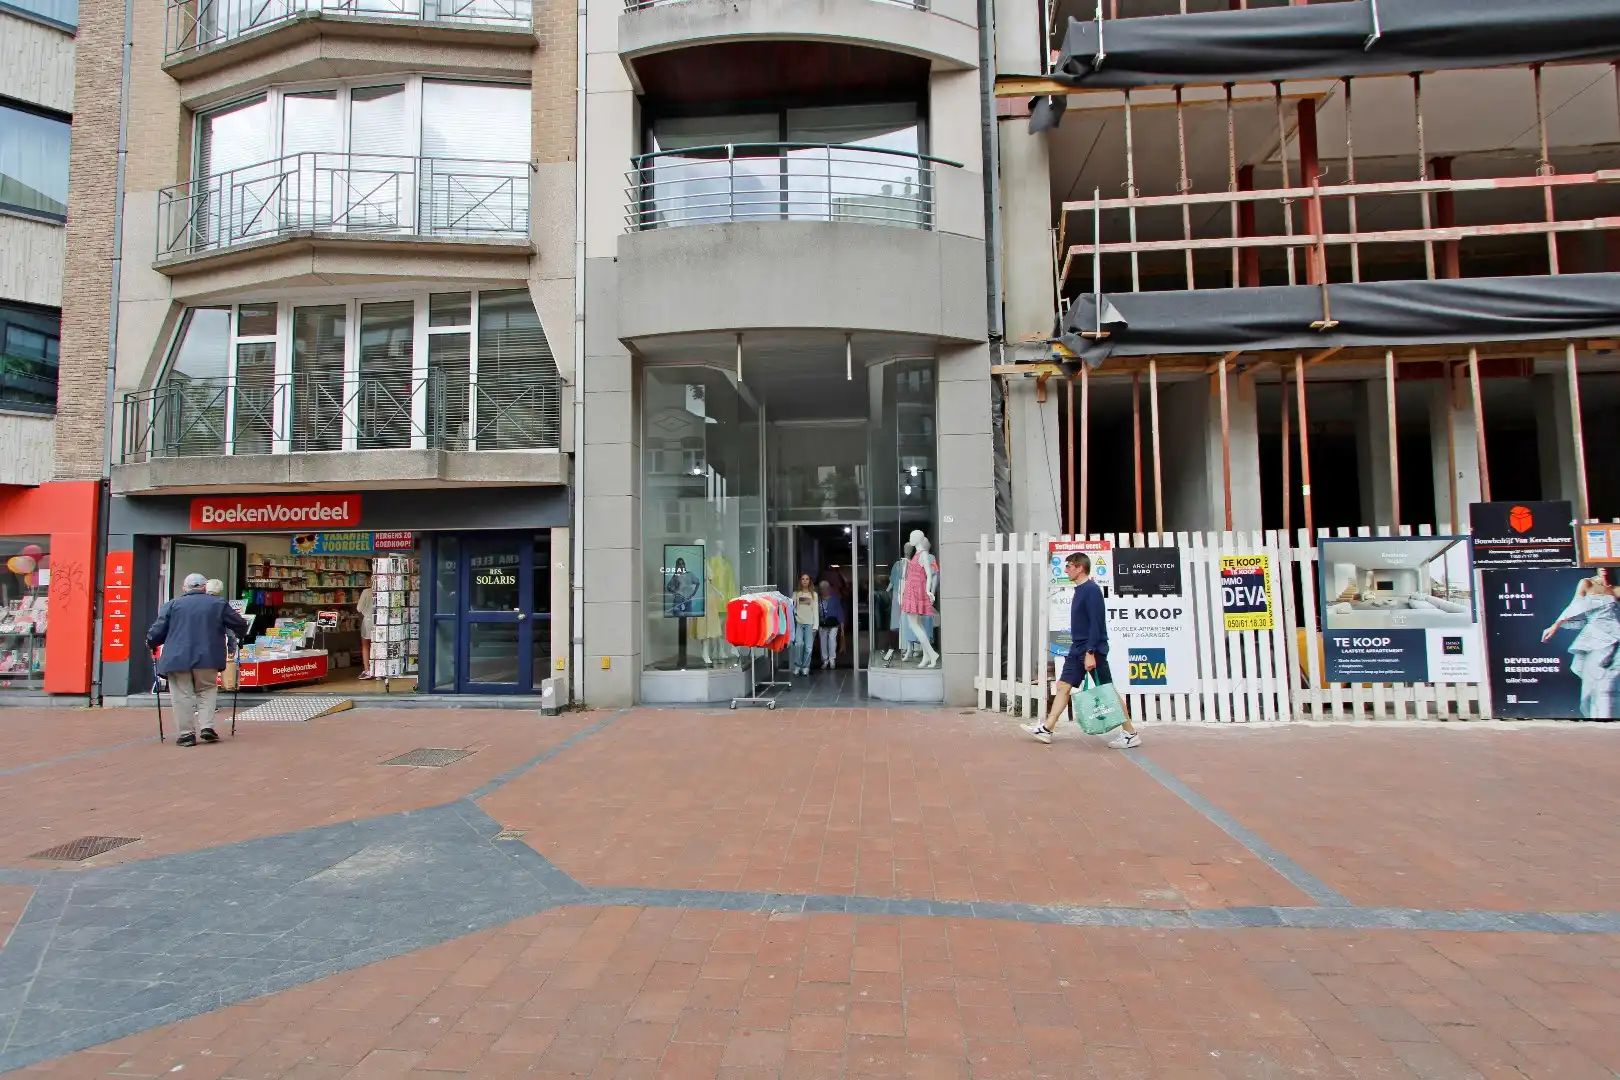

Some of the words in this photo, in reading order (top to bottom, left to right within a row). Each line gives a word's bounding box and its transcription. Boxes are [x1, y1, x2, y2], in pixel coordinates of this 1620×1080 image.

[202, 501, 348, 523] BoekenVoordeel
[375, 532, 403, 540] NERGENS
[403, 531, 412, 539] ZO
[322, 540, 370, 551] VOORDEEL
[375, 540, 411, 548] GOEDKOOP!
[1236, 558, 1261, 567] KOOP
[476, 575, 516, 585] SOLARIS
[1221, 577, 1243, 585] IMMO
[1221, 585, 1267, 607] DEVA
[1264, 556, 1273, 626] www.deva.be
[1107, 608, 1128, 620] TE
[1135, 608, 1183, 620] KOOP
[1227, 618, 1267, 628] 050/61.18.30
[1333, 637, 1350, 647] TE
[1353, 637, 1391, 647] KOOP
[272, 661, 318, 675] BoekenVoordeel
[1128, 662, 1167, 680] DEVA
